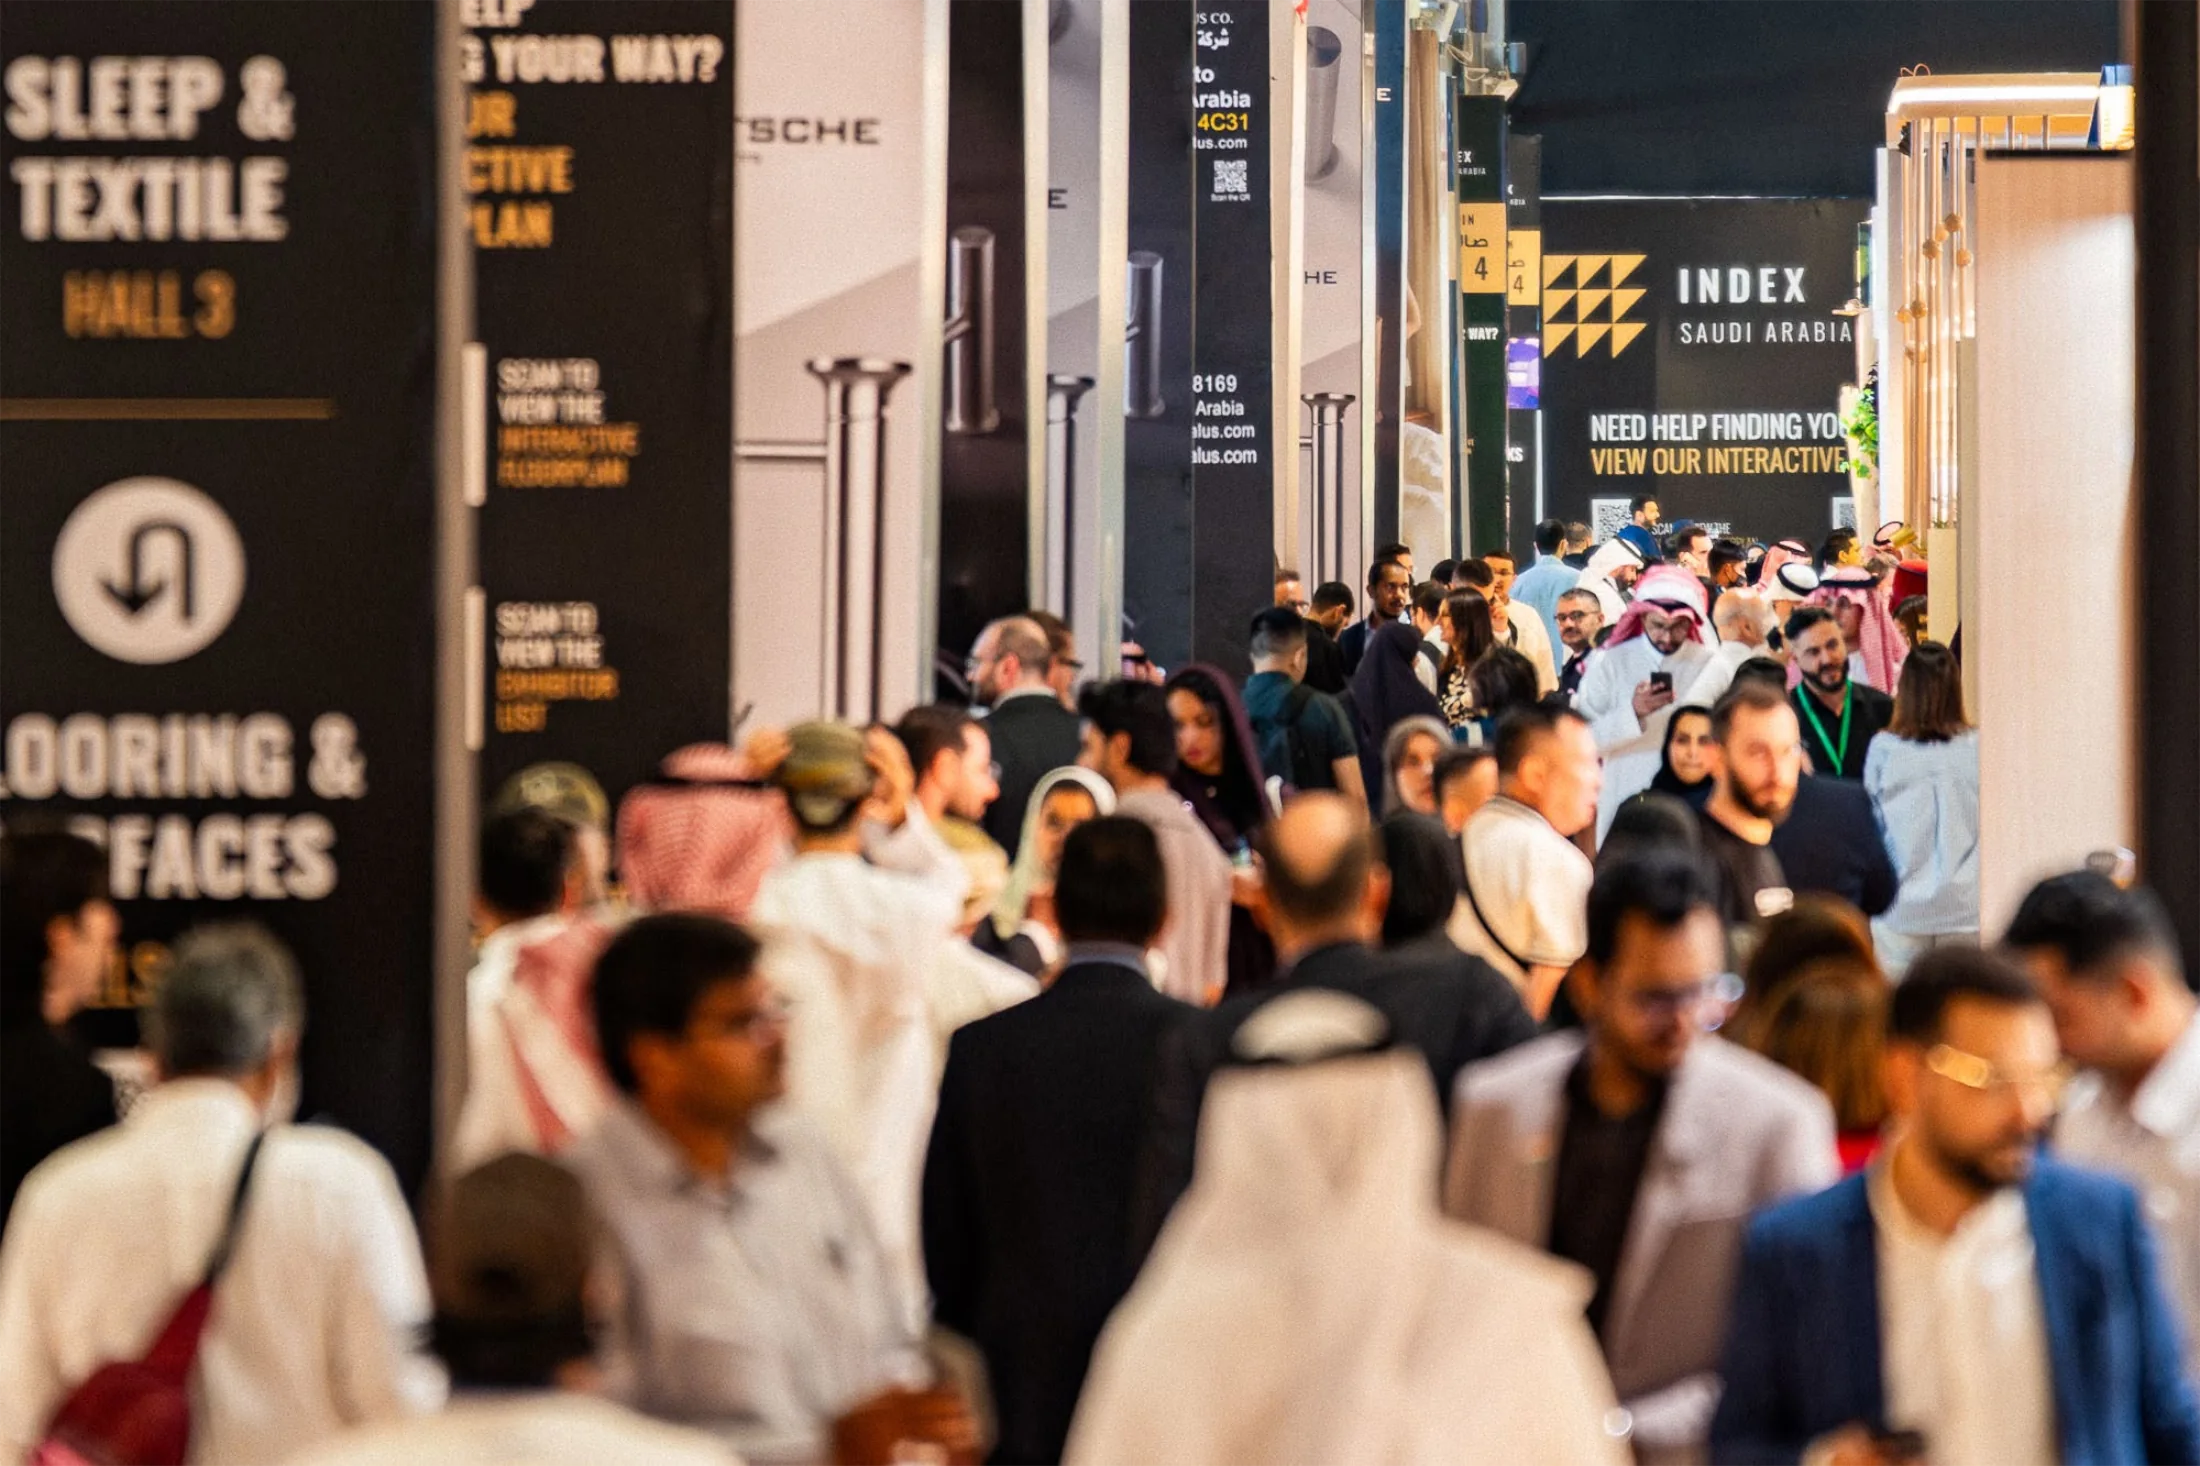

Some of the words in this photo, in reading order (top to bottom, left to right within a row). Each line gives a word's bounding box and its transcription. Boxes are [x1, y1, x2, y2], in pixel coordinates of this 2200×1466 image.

[1210, 12, 1235, 24] CO.
[1197, 28, 1230, 51] شركة
[491, 34, 606, 83] YOUR
[609, 34, 724, 83] WAY?
[1193, 66, 1215, 83] to
[4, 55, 225, 141] SLEEP
[237, 55, 297, 141] &
[1197, 112, 1249, 131] 4C31
[10, 156, 290, 241] TEXTILE
[1475, 256, 1488, 281] 4
[1513, 275, 1524, 293] 4
[1679, 267, 1806, 304] INDEX
[63, 269, 190, 338] HALL
[193, 268, 236, 338] 3
[1468, 327, 1498, 340] WAY?
[1680, 322, 1751, 344] SAUDI
[1765, 321, 1852, 343] ARABIA
[1192, 374, 1238, 393] 8169
[1195, 400, 1245, 416] Arabia
[1591, 414, 1647, 441] NEED
[1652, 414, 1707, 441] HELP
[1711, 413, 1802, 440] FINDING
[1590, 448, 1648, 475] VIEW
[1652, 448, 1702, 475] OUR
[1707, 446, 1848, 474] INTERACTIVE
[0, 712, 294, 799] OORING
[308, 712, 367, 799] &
